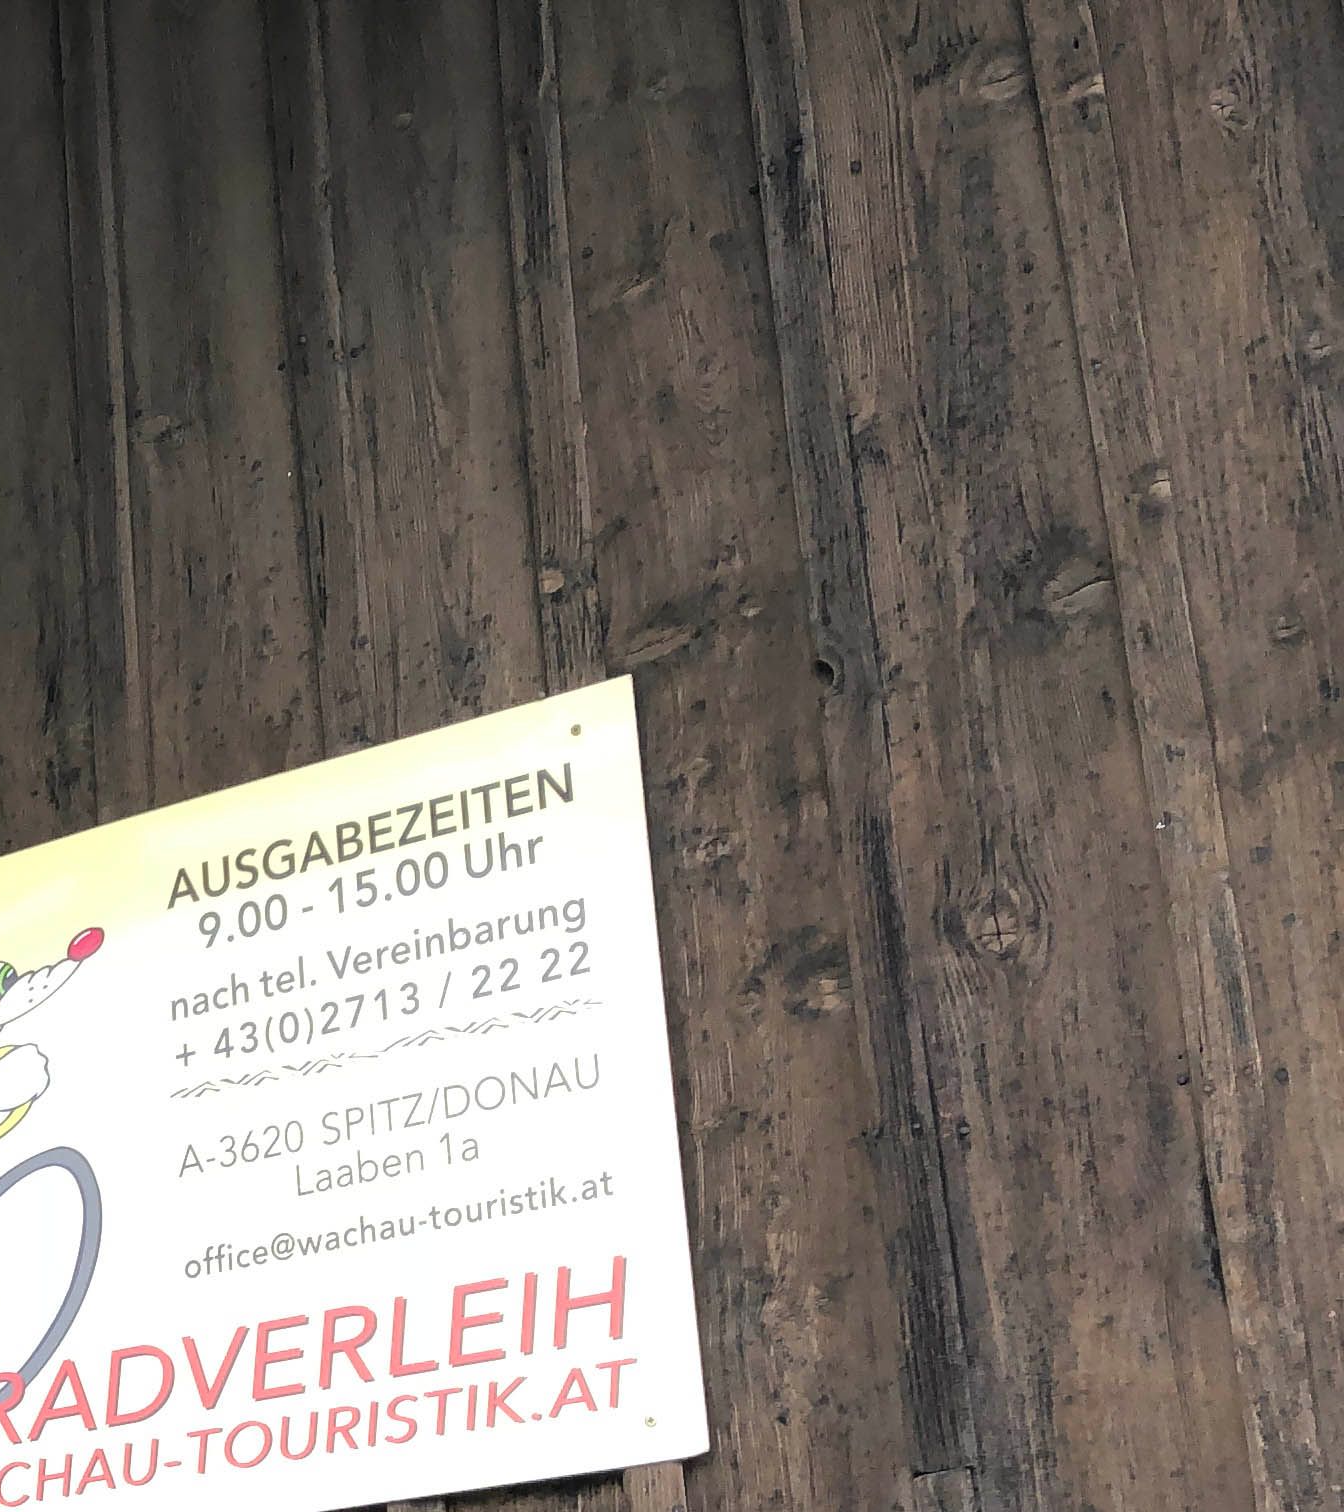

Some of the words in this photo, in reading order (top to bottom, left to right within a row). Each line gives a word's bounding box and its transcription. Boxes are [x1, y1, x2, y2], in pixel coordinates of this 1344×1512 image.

[167, 762, 574, 910] AUSGABEZEITEN
[198, 893, 288, 949] 9.00
[328, 851, 449, 914] 15.00
[463, 832, 544, 879] Uhr
[170, 973, 249, 1021] nach
[259, 955, 317, 998] tel.
[326, 897, 587, 980] Vereinbarung
[213, 981, 421, 1060] 43(0)2713
[471, 958, 521, 1000] 22
[540, 941, 591, 984] 22
[178, 1120, 305, 1178] A-3620
[321, 1053, 601, 1146] SPITZ/DONAU
[295, 1149, 425, 1197] Laaben
[439, 1132, 480, 1166] 1a
[184, 1170, 615, 1279] office@wachau-touristik.at
